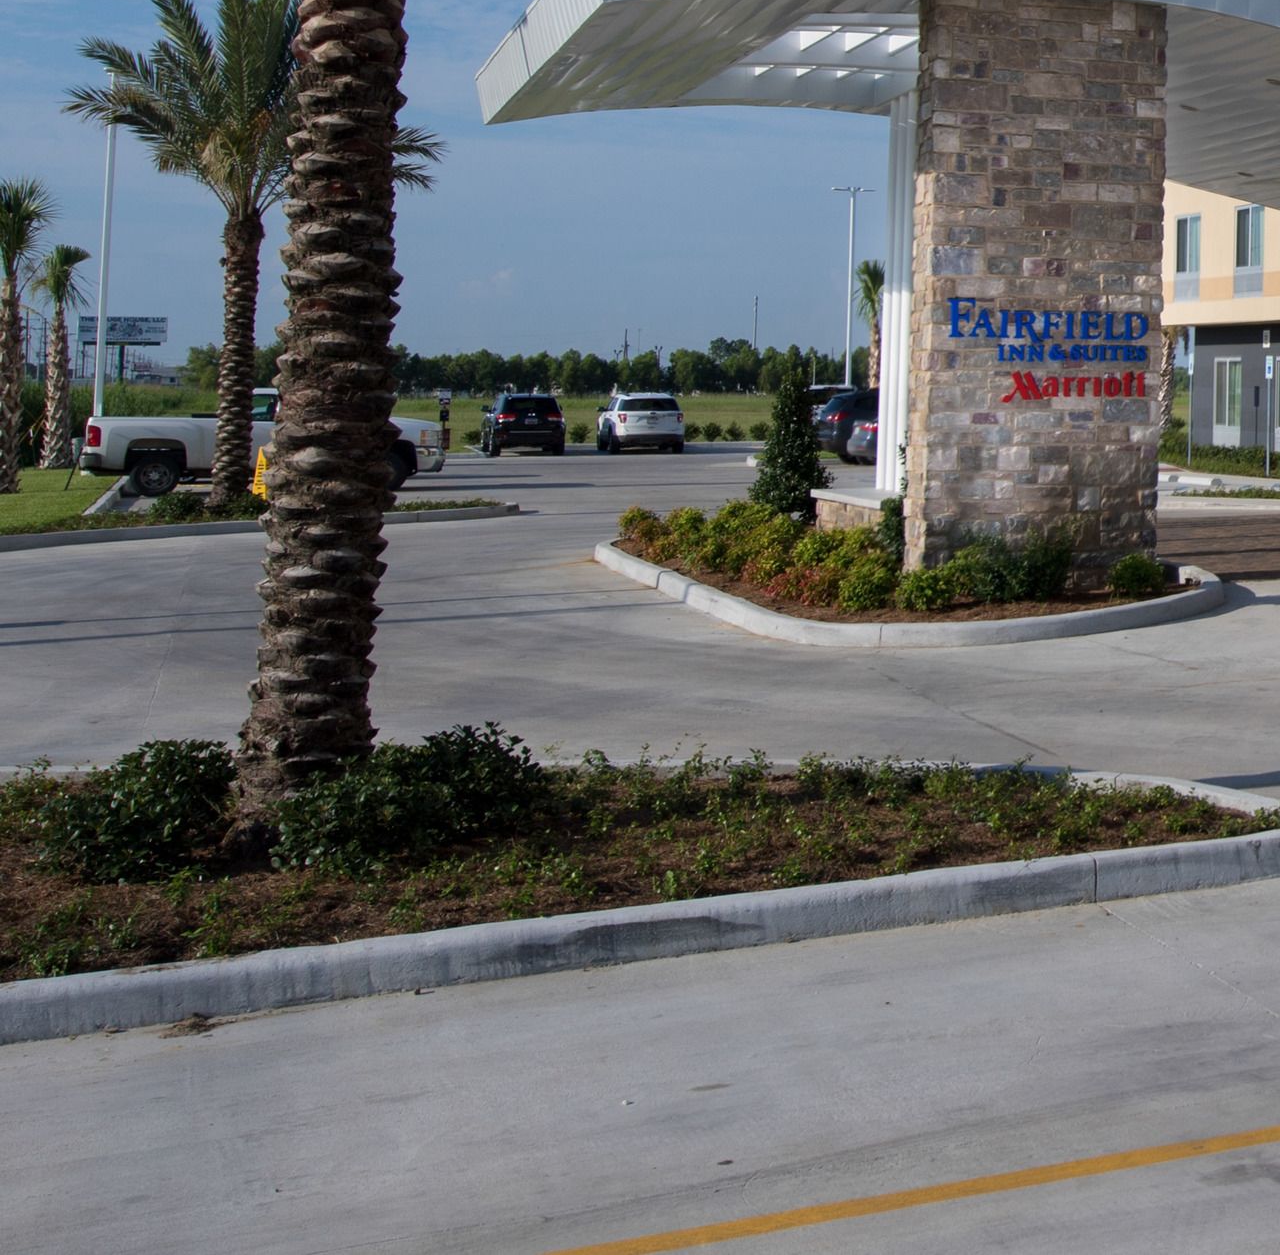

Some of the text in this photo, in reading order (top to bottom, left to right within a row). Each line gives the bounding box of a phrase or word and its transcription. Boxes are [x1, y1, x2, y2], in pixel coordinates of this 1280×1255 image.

[947, 297, 1149, 343] FAIRFIELD
[997, 343, 1148, 363] INN & SUITES
[1001, 370, 1147, 403] Marriott
